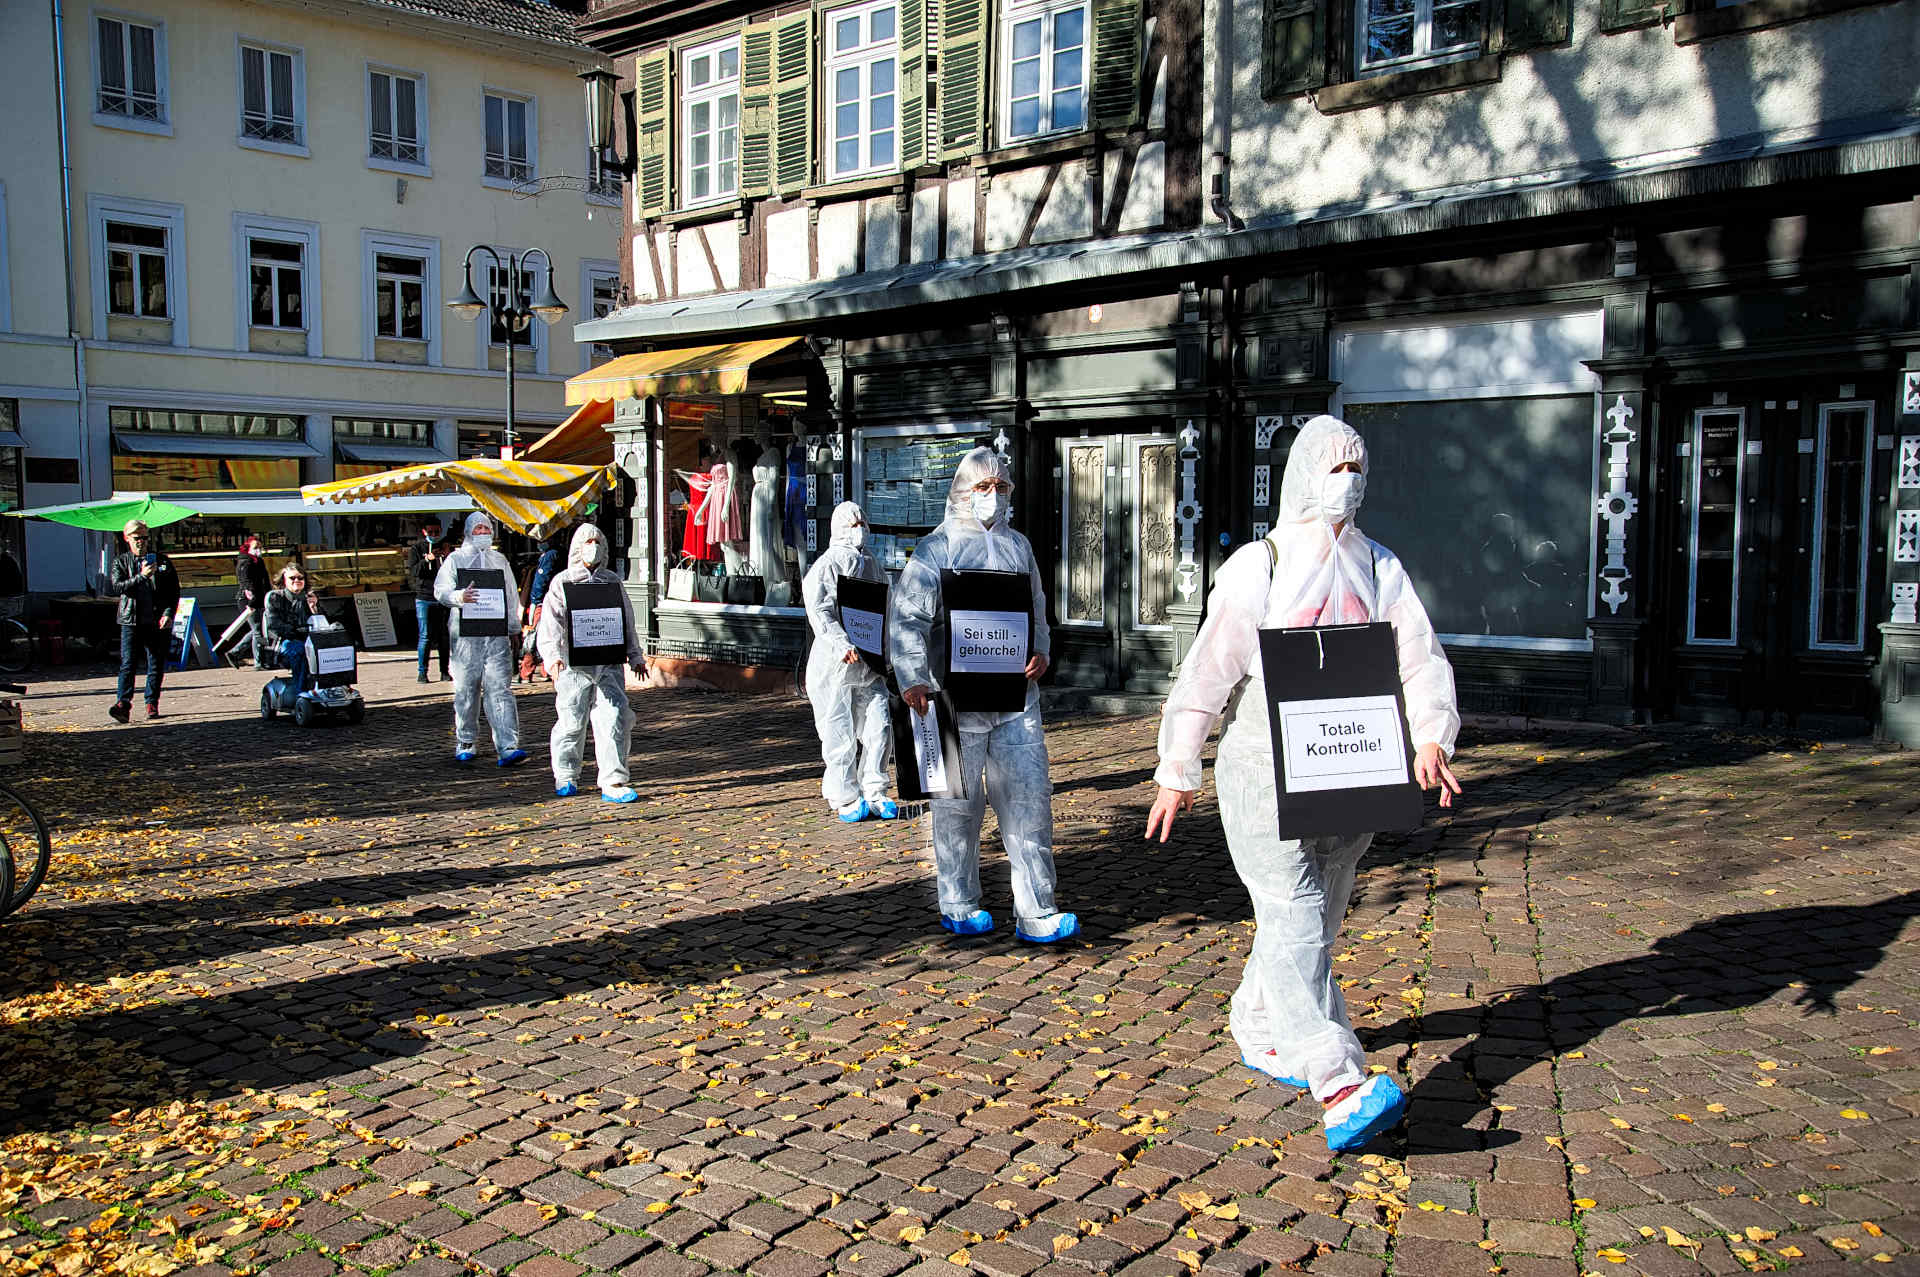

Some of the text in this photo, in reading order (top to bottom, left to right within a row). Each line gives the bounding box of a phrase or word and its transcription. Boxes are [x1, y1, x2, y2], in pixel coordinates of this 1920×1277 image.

[357, 598, 383, 606] Oliven
[964, 627, 983, 640] Sei
[987, 629, 1009, 641] still
[959, 644, 1020, 658] gehorche!
[1319, 721, 1366, 737] Totale
[1305, 738, 1383, 757] Kontrolle!
